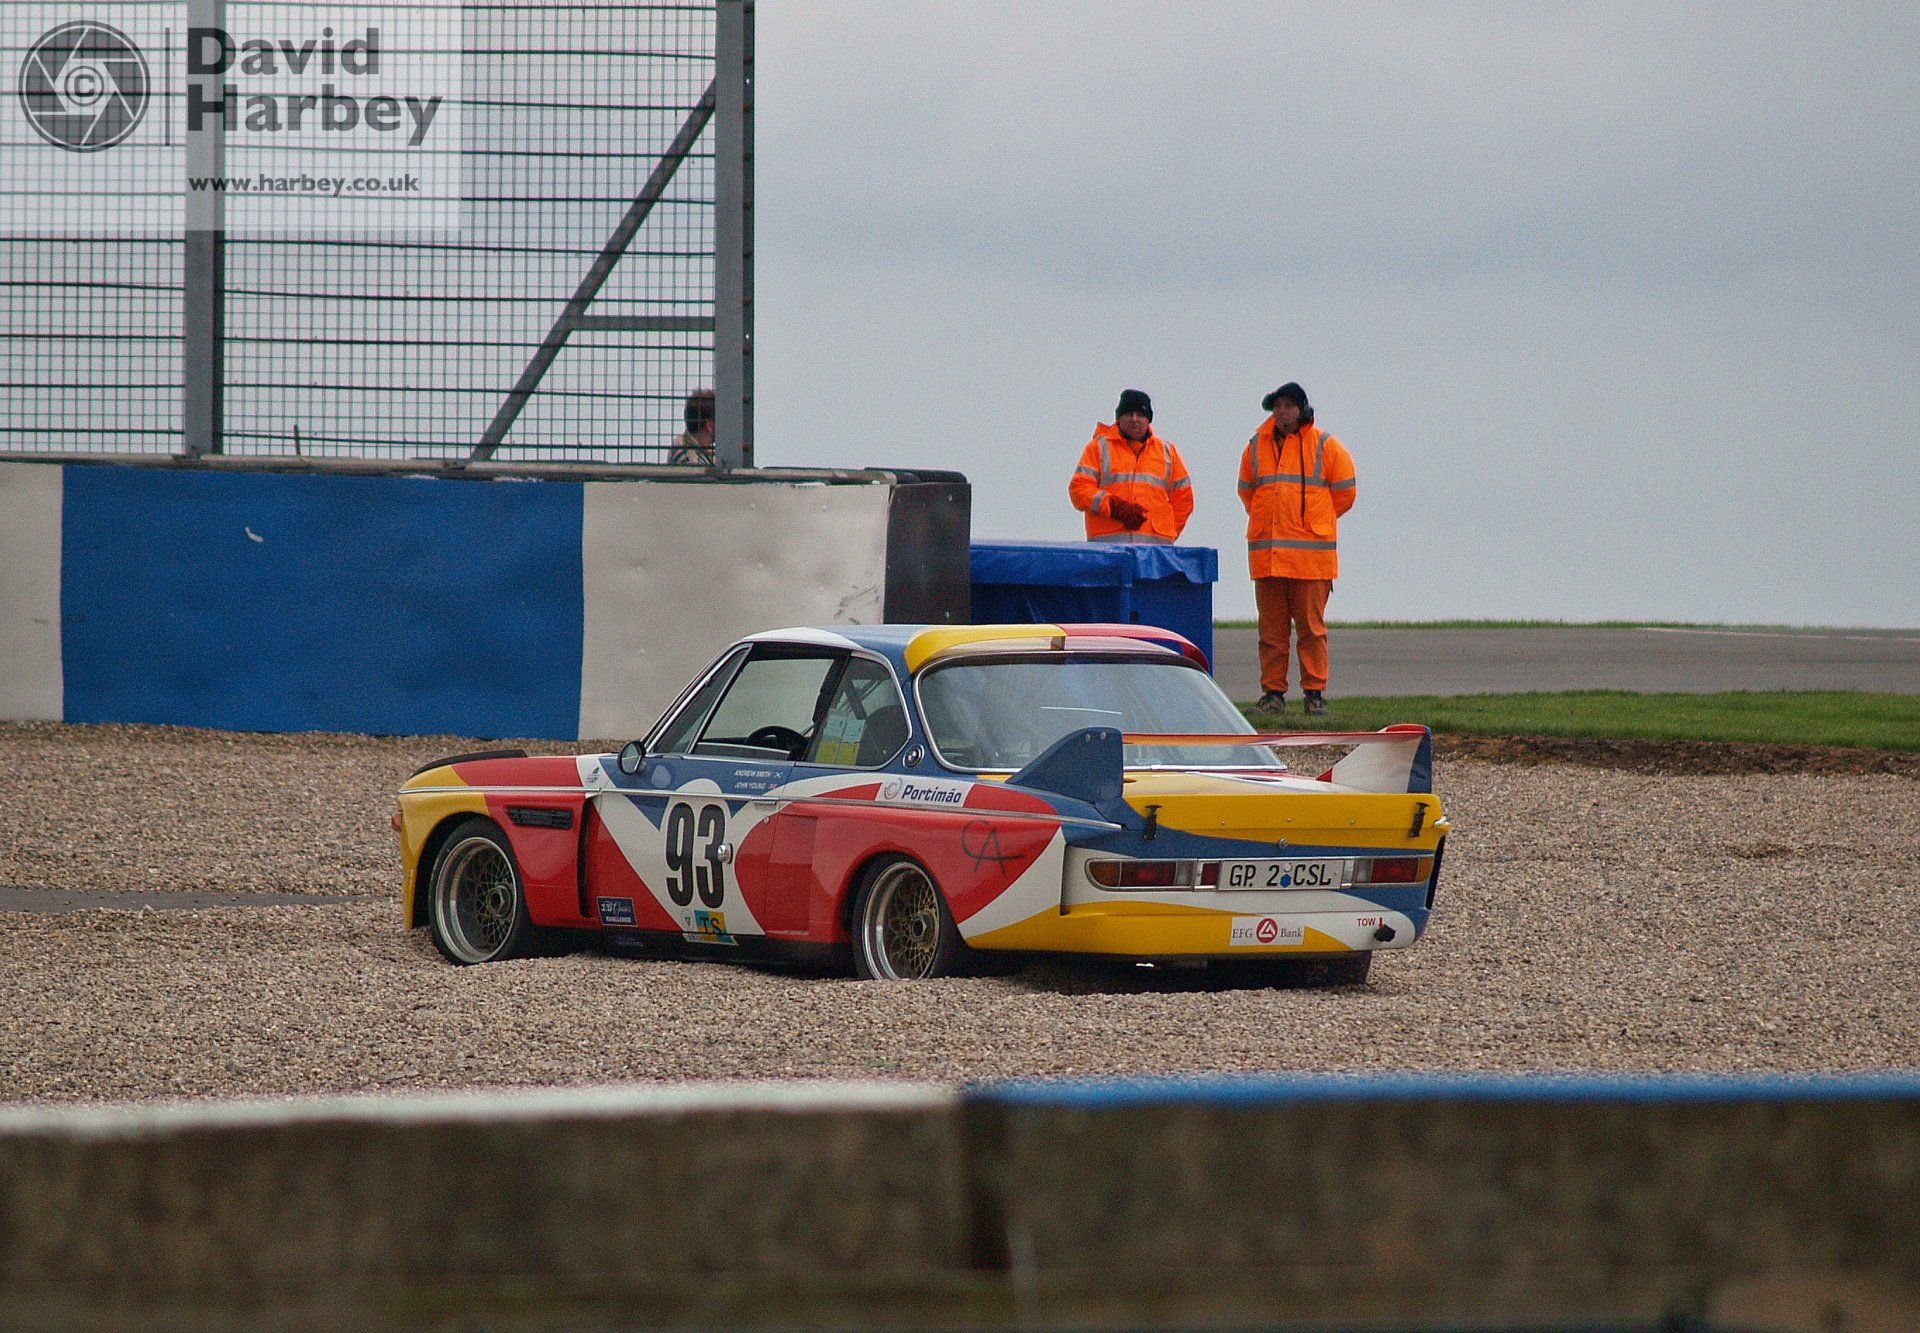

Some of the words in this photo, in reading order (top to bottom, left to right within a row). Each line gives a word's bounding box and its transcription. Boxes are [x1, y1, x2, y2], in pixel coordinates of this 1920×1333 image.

[666, 802, 727, 909] 93
[1266, 864, 1280, 887] 2
[1293, 864, 1332, 886] CSL
[1356, 918, 1376, 927] TOW
[1232, 928, 1253, 939] EFG
[1280, 928, 1303, 938] Bank
